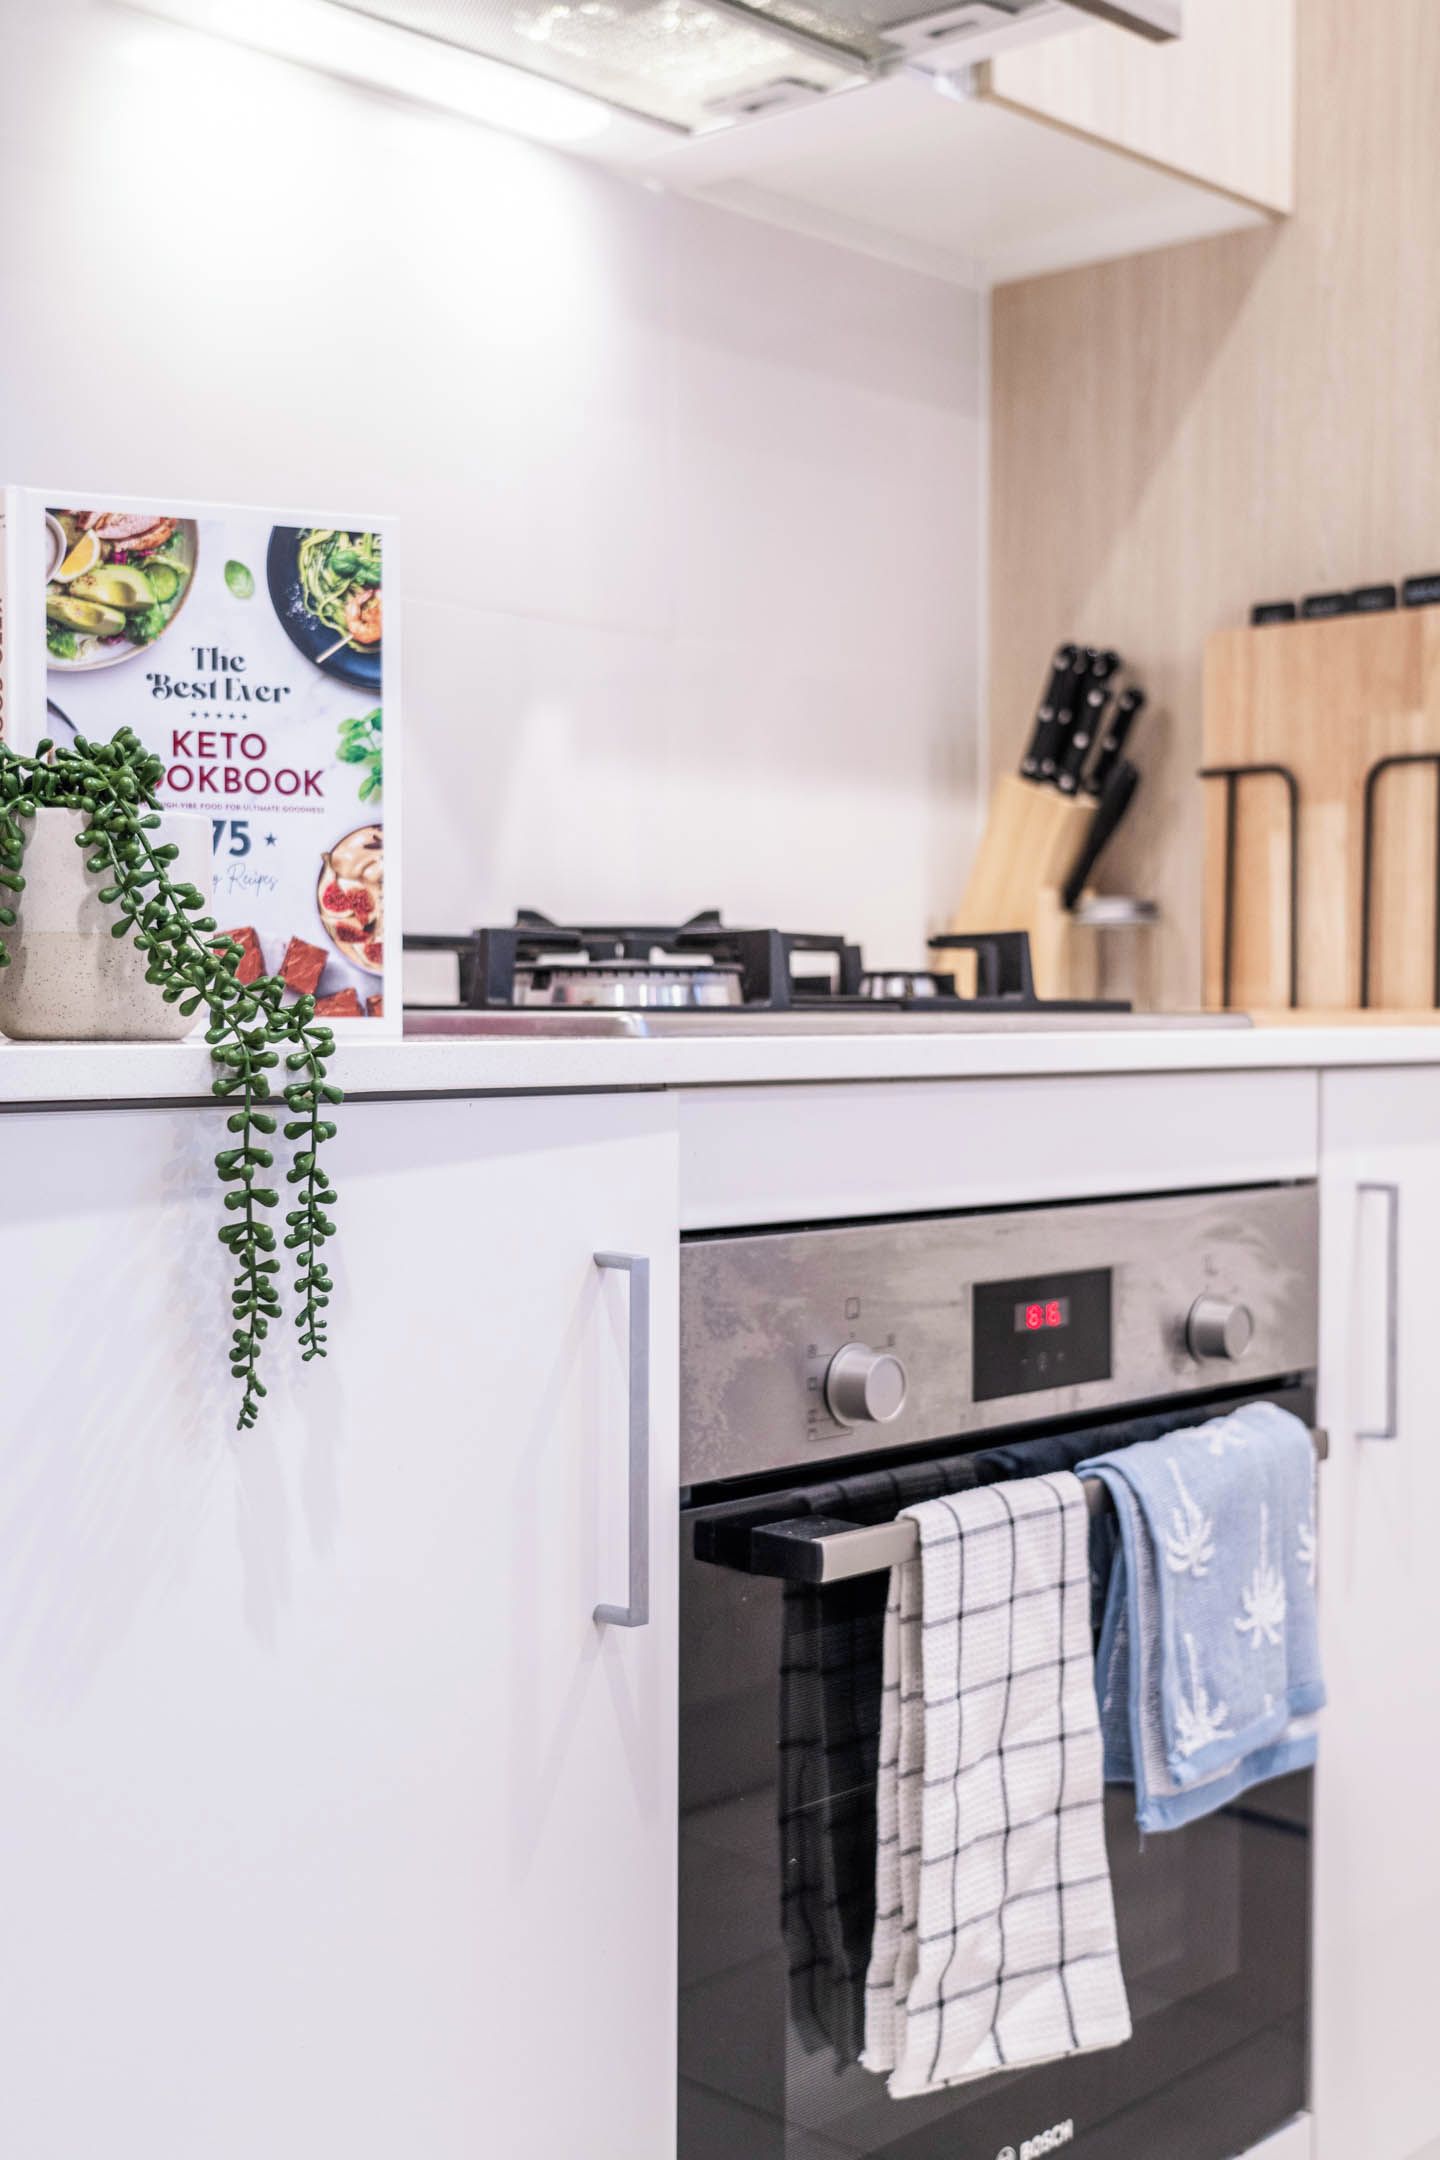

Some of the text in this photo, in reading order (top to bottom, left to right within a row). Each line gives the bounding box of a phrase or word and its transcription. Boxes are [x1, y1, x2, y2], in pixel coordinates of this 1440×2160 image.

[191, 647, 247, 672] The
[146, 673, 291, 703] Best Ever
[172, 730, 267, 760] KETO
[155, 765, 325, 797] OKBOOK
[1020, 2118, 1074, 2160] BOSCH
